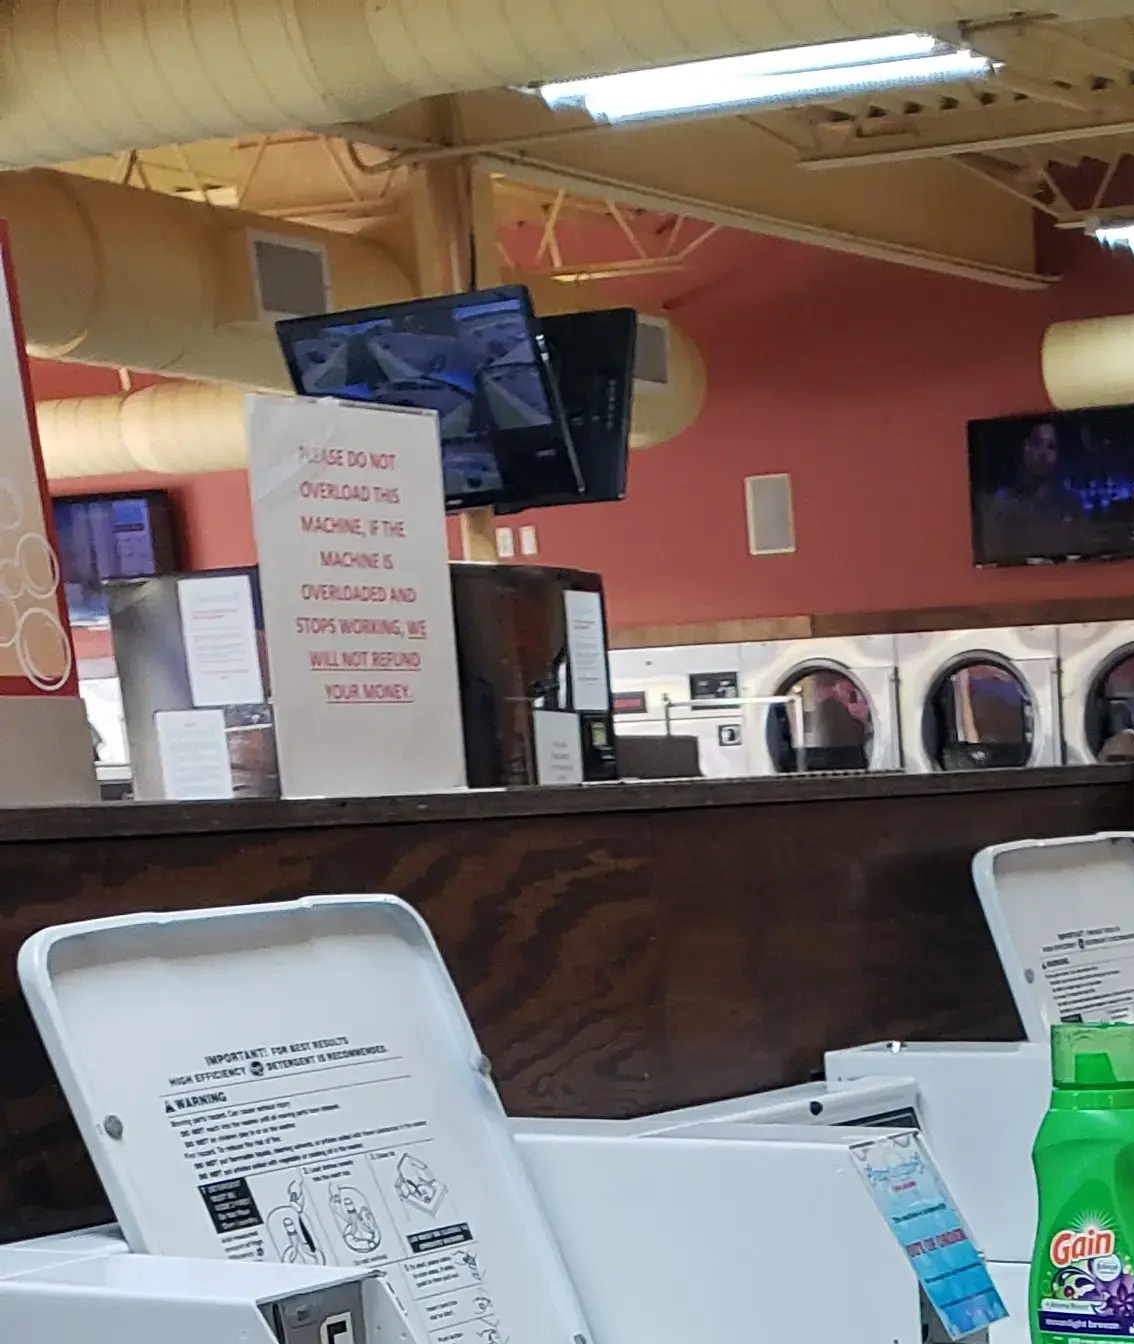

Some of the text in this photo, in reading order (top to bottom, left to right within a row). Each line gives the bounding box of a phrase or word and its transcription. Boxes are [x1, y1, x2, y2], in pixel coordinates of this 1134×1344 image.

[347, 449, 367, 468] DO
[370, 452, 396, 470] NOT
[300, 480, 400, 504] OVERLOAD THIS
[300, 515, 406, 538] MACHINE, IF THE
[320, 551, 394, 569] MACHINE IS
[301, 583, 418, 603] OVERLOADED AND
[295, 617, 427, 637] STOPS WORKING, WE
[310, 651, 421, 668] WILL NOT REFUND
[325, 683, 359, 699] YOUR
[204, 1047, 267, 1066] IMPORTANT!
[194, 1066, 248, 1084] EFFICIENCY
[175, 1091, 228, 1110] WARNING
[1052, 1228, 1114, 1267] Gain
